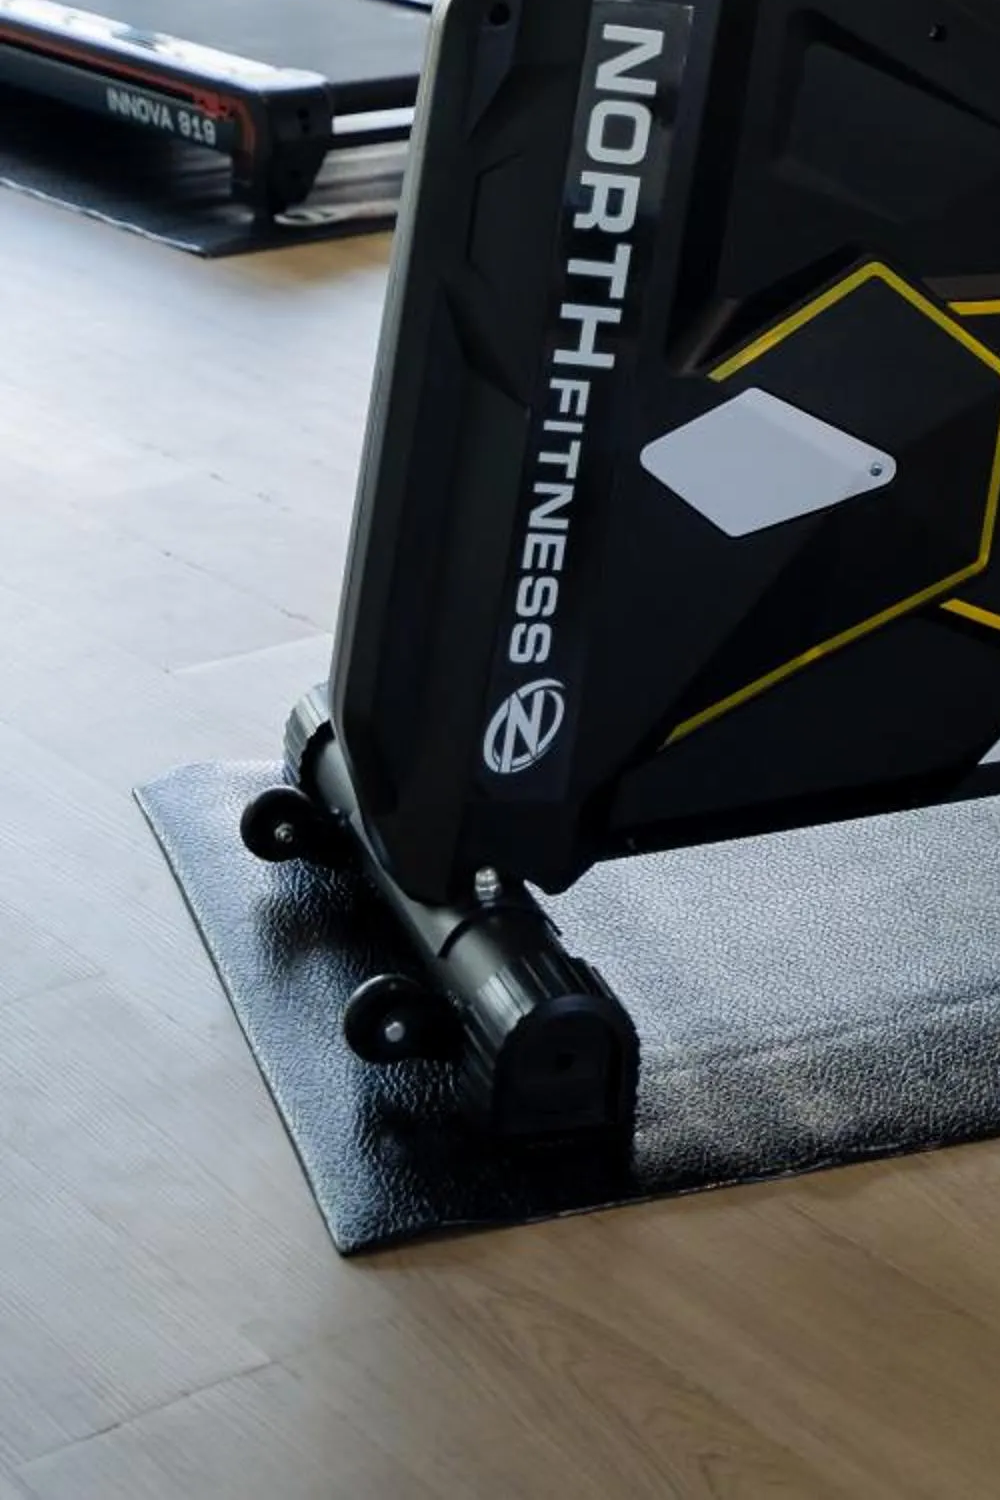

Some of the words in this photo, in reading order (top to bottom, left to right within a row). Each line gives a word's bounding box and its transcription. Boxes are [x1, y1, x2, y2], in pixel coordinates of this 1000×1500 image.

[107, 87, 174, 131] INNOVA
[553, 23, 664, 369] NORTH
[509, 378, 591, 663] FITNESS
